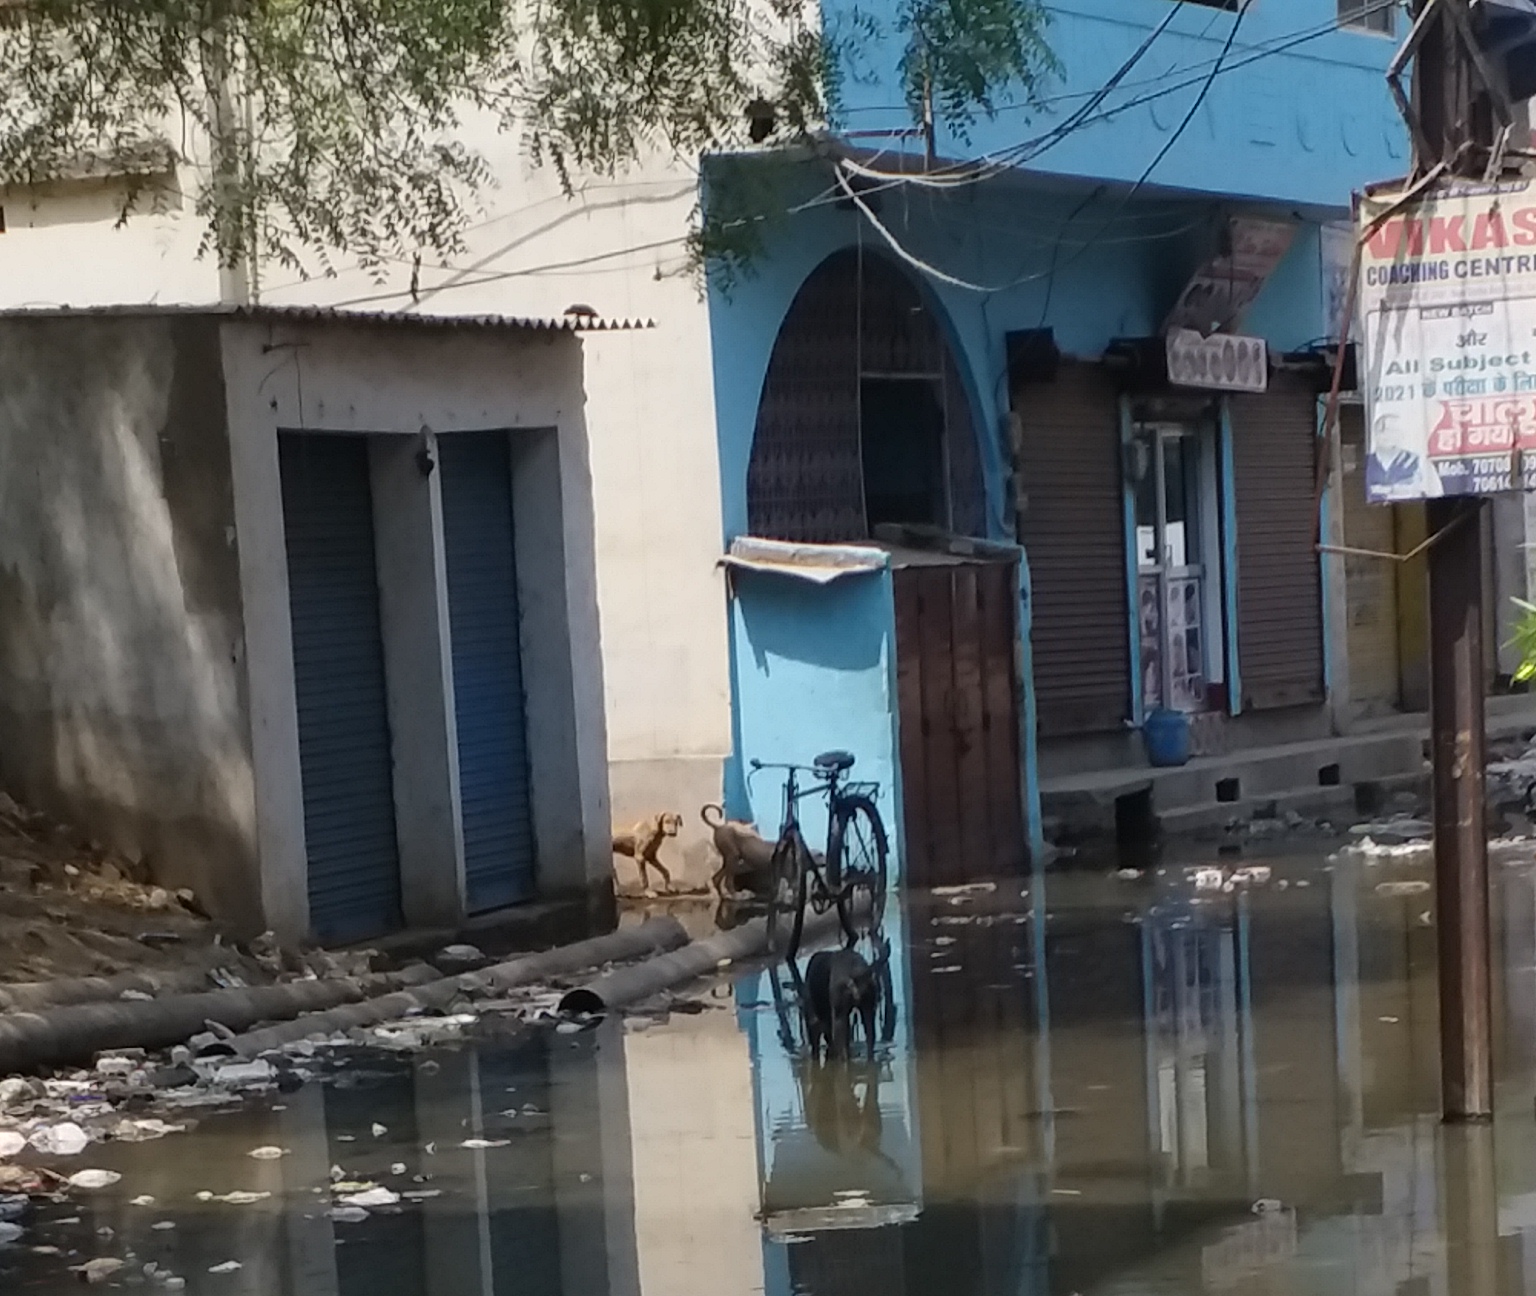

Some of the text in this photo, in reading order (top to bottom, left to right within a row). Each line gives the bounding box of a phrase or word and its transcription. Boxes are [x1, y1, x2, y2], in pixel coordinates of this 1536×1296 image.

[1367, 261, 1449, 286] COACHING
[1456, 329, 1487, 348] और
[1385, 351, 1531, 375] All Subject
[1375, 384, 1415, 402] 2021
